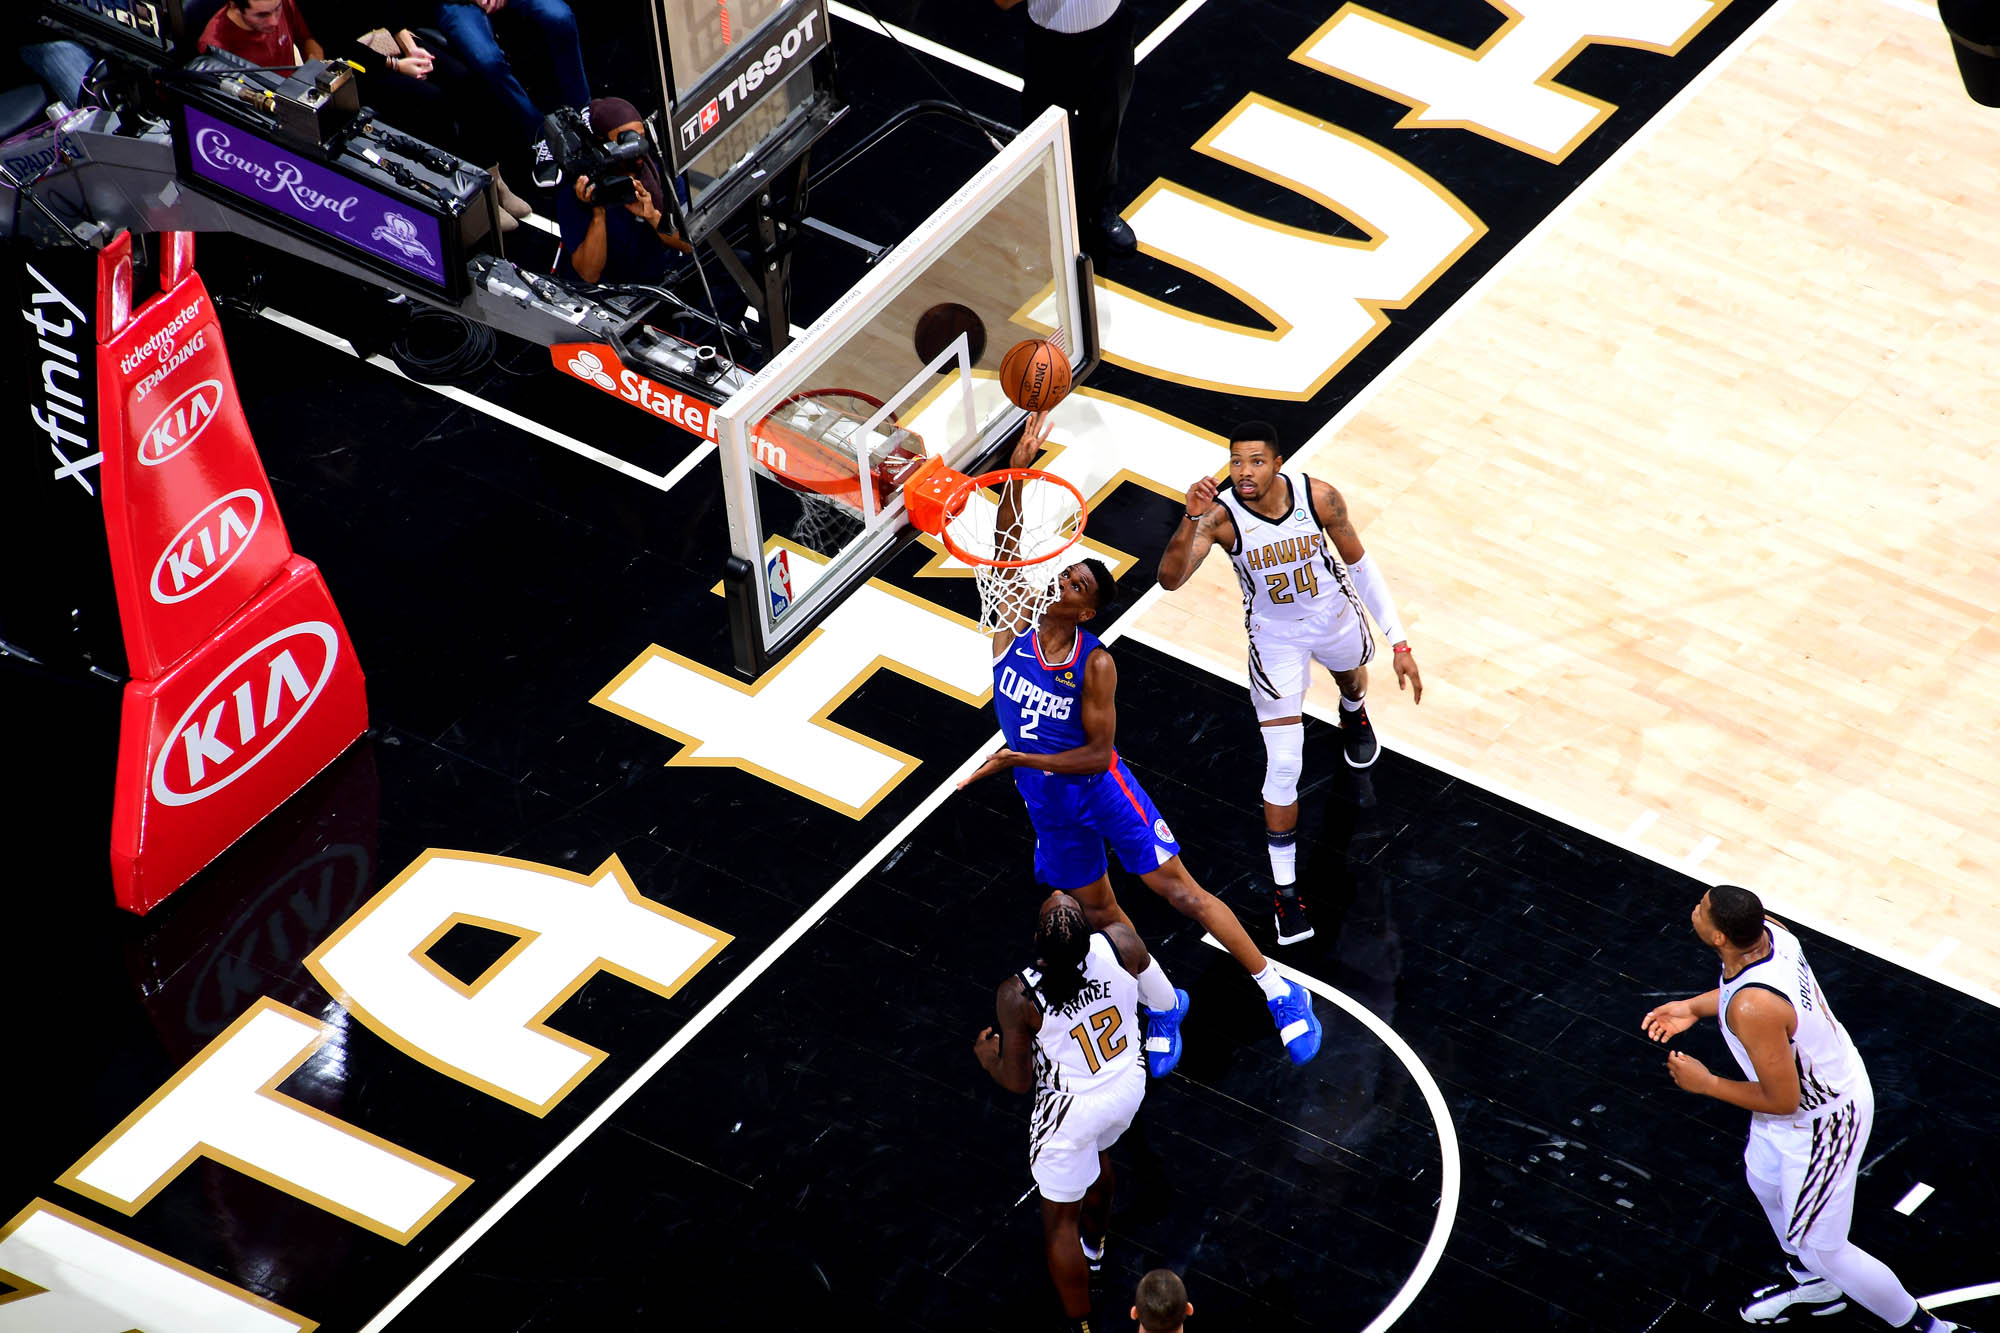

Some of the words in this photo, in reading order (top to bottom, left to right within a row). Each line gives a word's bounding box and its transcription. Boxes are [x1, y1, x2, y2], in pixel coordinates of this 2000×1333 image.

[718, 9, 818, 112] TISSOT
[4, 136, 83, 180] SPALDIG
[196, 128, 272, 182] Crown
[255, 161, 358, 222] Royal
[120, 299, 200, 375] ticketmaster
[135, 330, 205, 402] SPALDING
[22, 262, 104, 496] xfinity
[152, 393, 211, 456] KIA
[620, 369, 703, 433] State
[706, 407, 787, 473] Fm
[166, 506, 248, 592] KIA
[1264, 561, 1319, 605] 24
[181, 649, 311, 788] KIA
[999, 666, 1074, 721] CLIPPERS
[1019, 708, 1040, 740] 2
[1062, 981, 1112, 1021] PRINCE
[1069, 1004, 1128, 1075] 12
